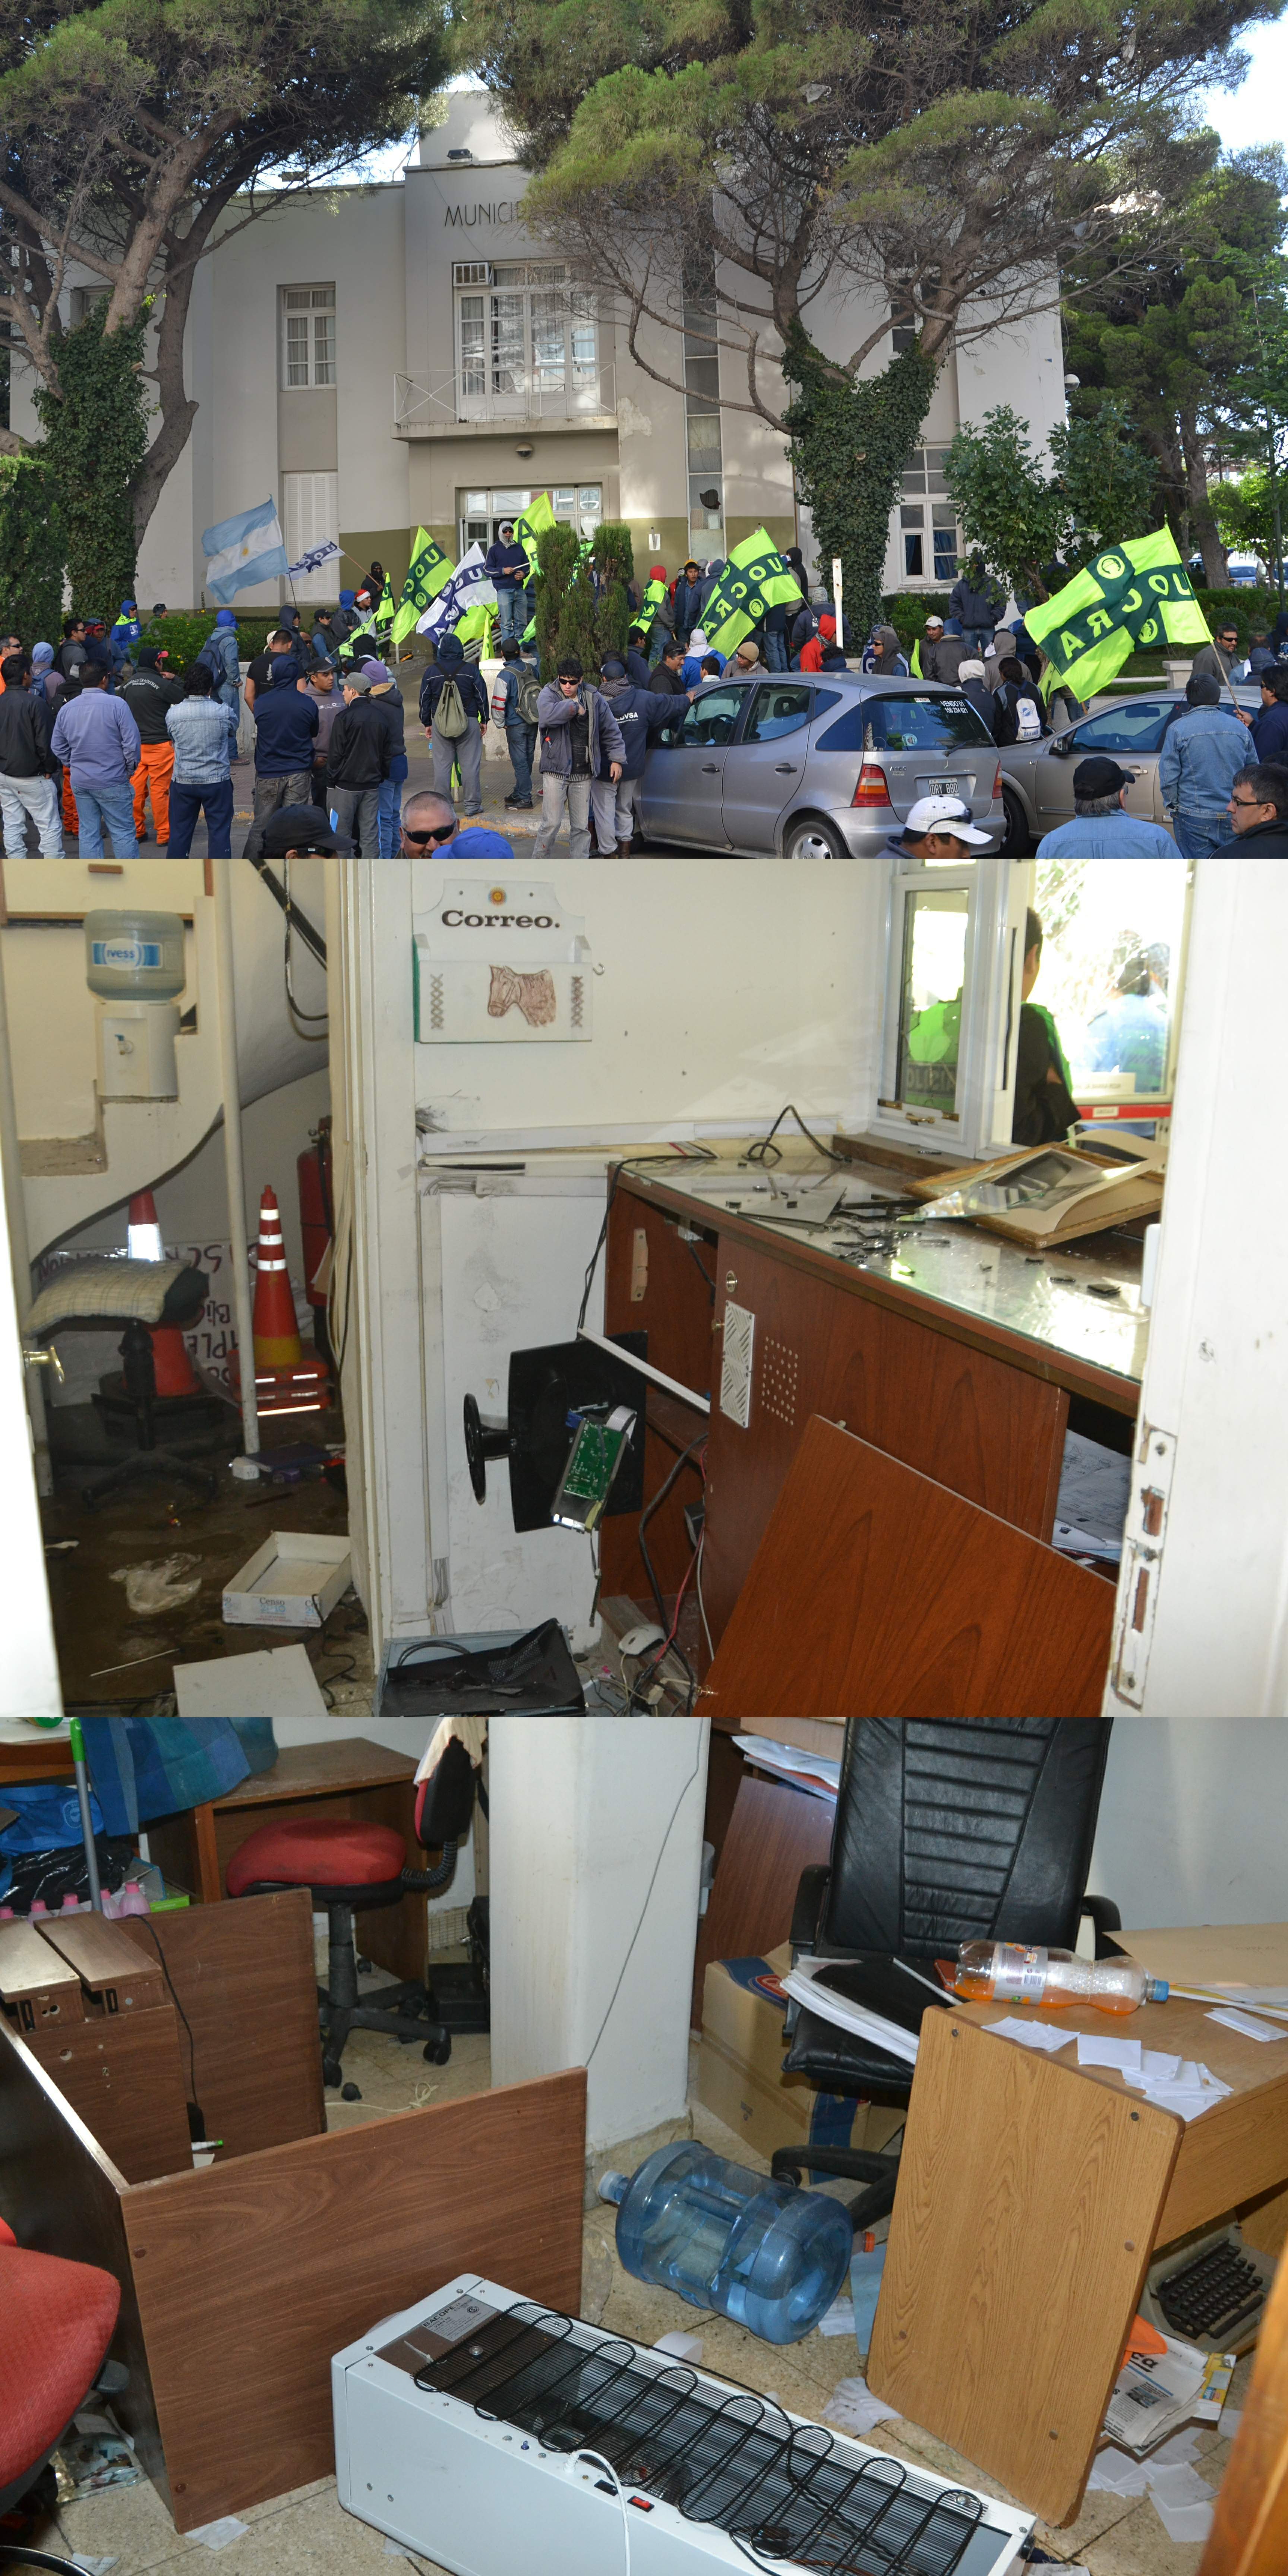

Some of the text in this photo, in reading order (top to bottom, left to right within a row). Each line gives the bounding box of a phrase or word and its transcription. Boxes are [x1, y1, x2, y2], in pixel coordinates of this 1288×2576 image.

[931, 783, 958, 795] DRY 880
[442, 910, 560, 928] Correo.
[423, 2305, 456, 2327] BACOPE
